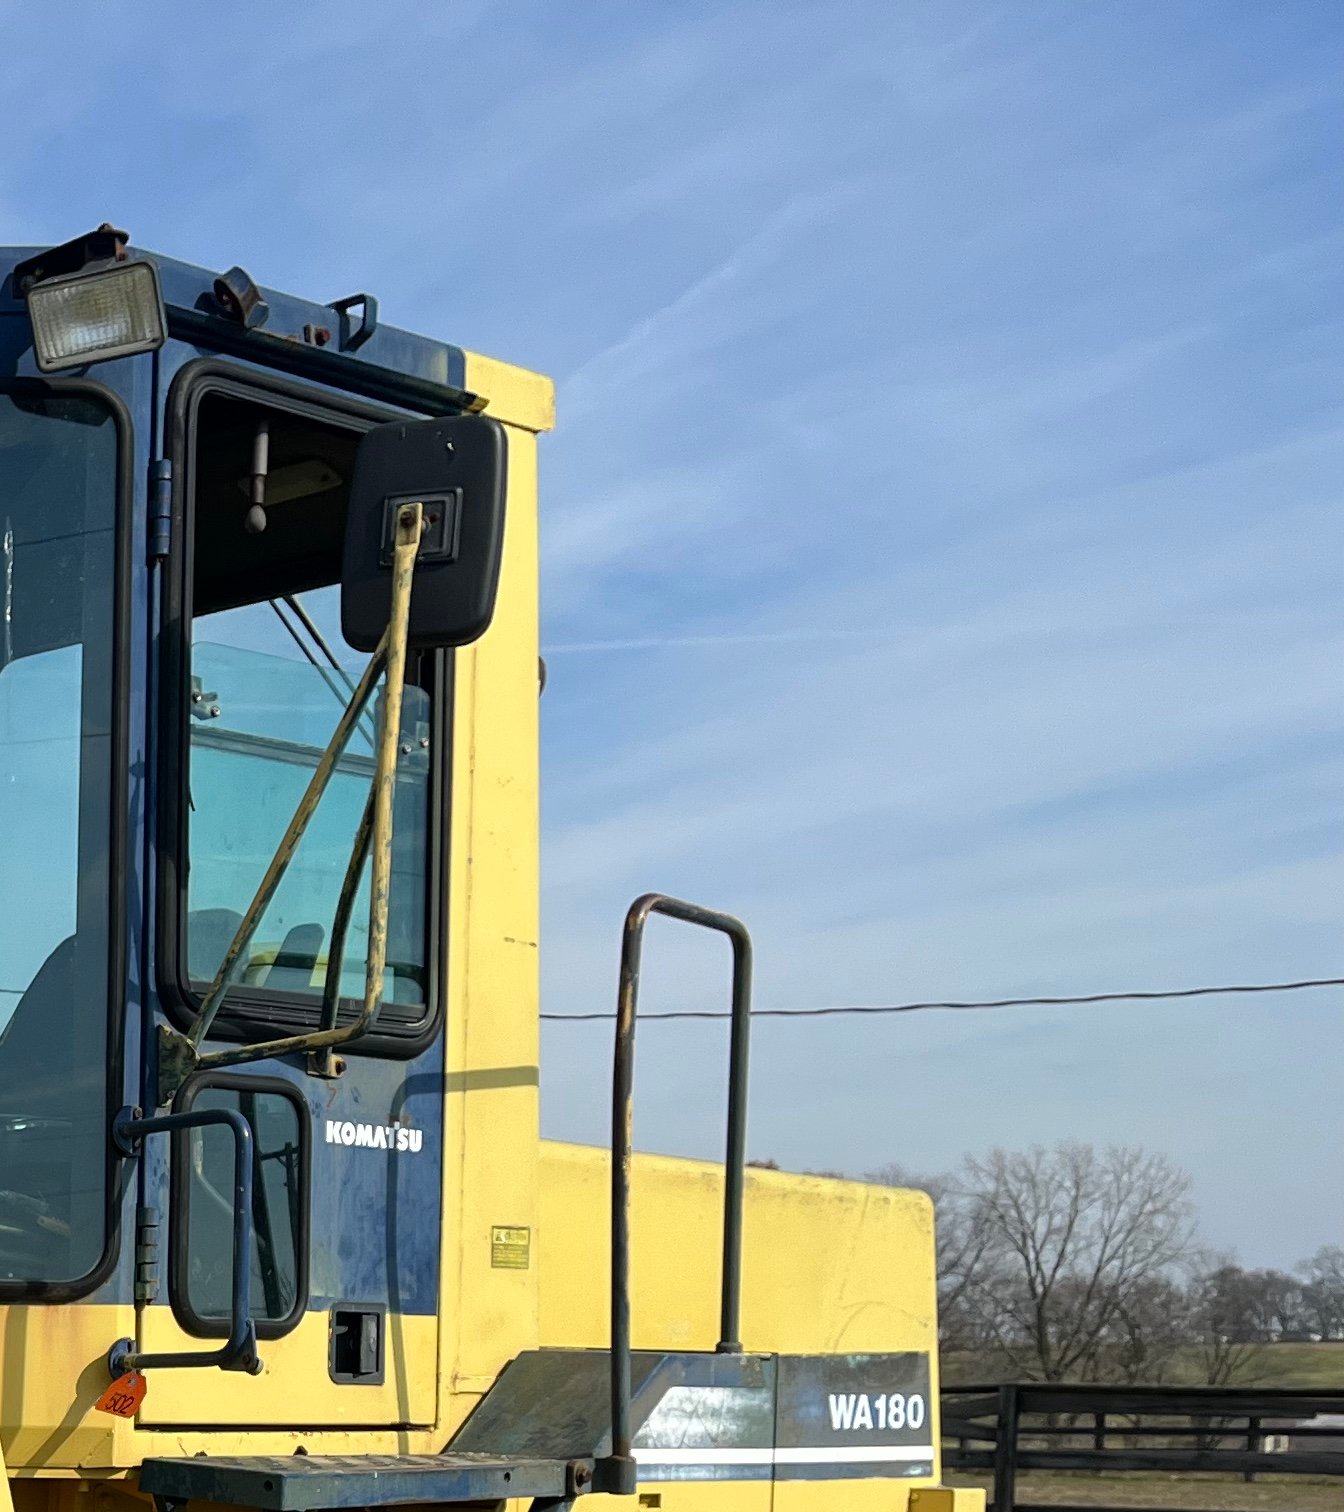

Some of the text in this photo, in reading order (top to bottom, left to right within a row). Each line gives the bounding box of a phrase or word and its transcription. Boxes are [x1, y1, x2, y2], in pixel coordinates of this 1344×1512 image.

[325, 1119, 423, 1153] KOMATSU
[105, 1392, 135, 1415] 502
[828, 1393, 925, 1431] WA180
